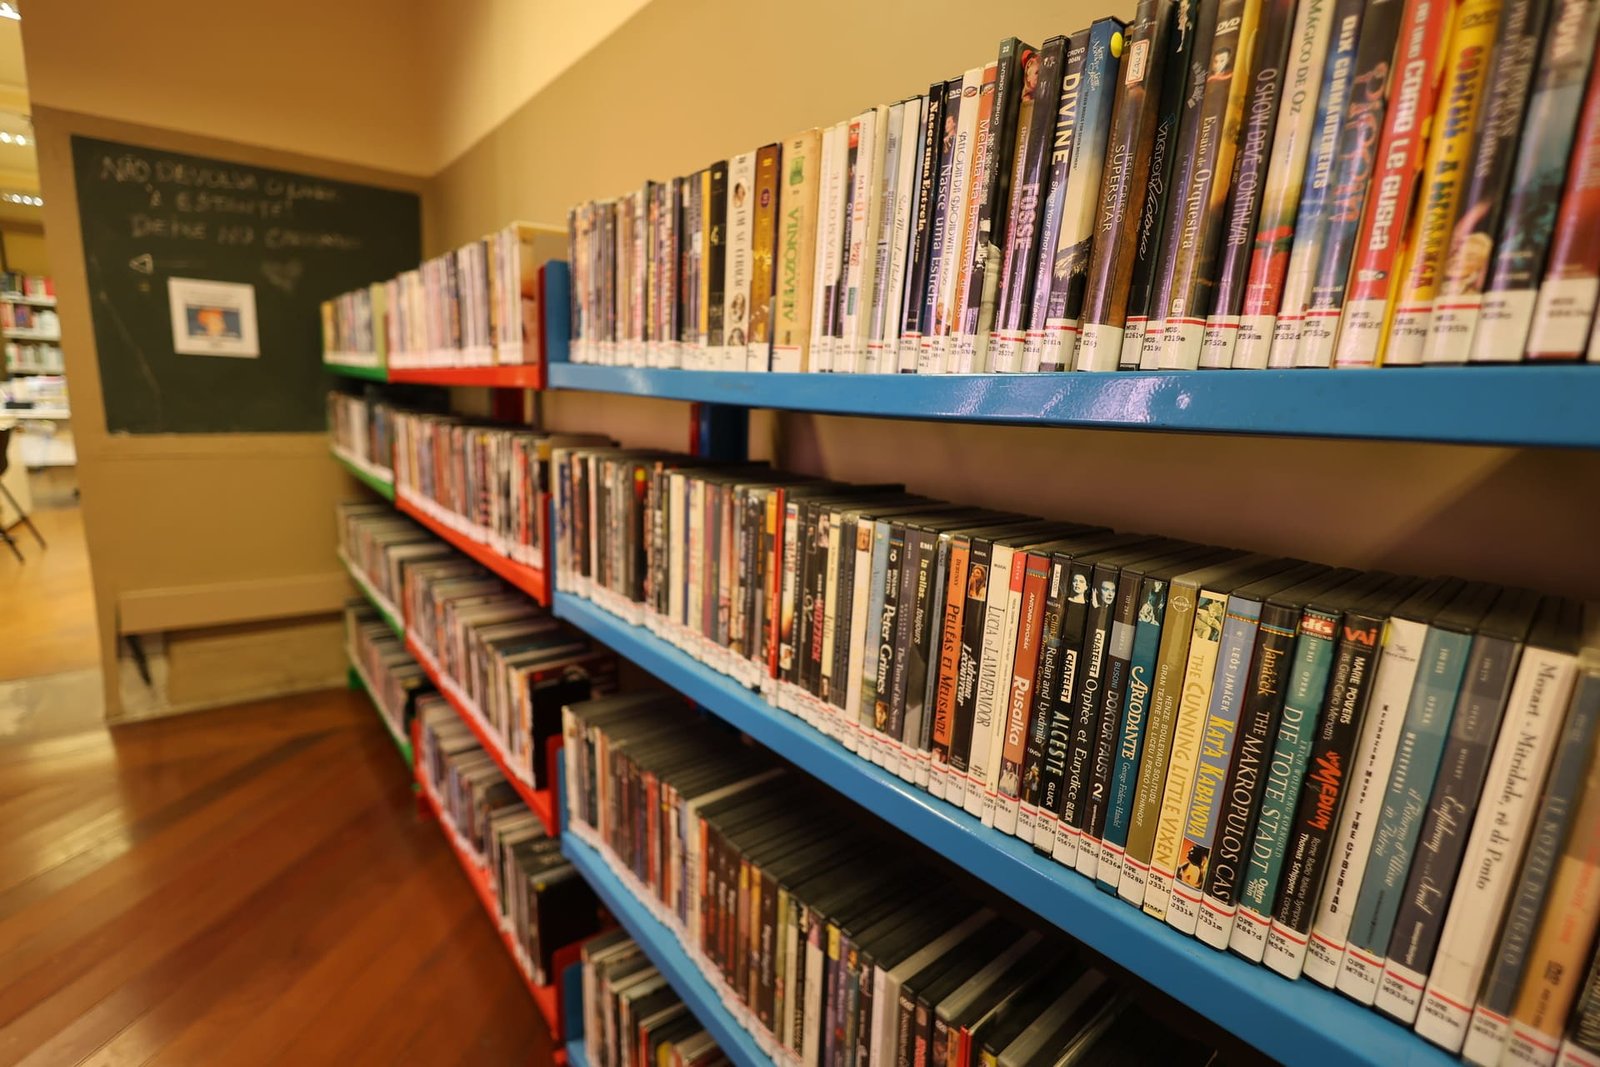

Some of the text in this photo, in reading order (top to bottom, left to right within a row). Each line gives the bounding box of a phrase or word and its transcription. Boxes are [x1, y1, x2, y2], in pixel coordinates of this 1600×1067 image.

[1216, 17, 1241, 32] DVD
[1052, 72, 1081, 166] DIVINE
[1251, 82, 1276, 124] SHOW
[1201, 116, 1217, 156] Ensaio
[1246, 124, 1267, 168] DEVE
[1101, 144, 1126, 233] SUPERSTAR
[1182, 168, 1211, 249] Orquestra
[876, 604, 895, 695] Peter Grimes
[946, 604, 961, 658] PELLÉAS
[942, 660, 951, 672] ET
[957, 643, 972, 706] Lecouvreur
[964, 658, 977, 699] Adriana
[976, 606, 1005, 727] LUCIA LAMMERMOOR
[1061, 649, 1076, 701] CHATELET
[1111, 661, 1121, 691] BUSONI
[1258, 647, 1284, 696] Janáček
[1340, 657, 1366, 725] MARIE POWERS
[1527, 661, 1558, 717] Mozart
[1007, 675, 1031, 747] Rusalka
[1034, 647, 1058, 751] Ruslan and Lyudmila
[1064, 629, 1105, 823] CHATELET et Eurydice GLUCK
[1104, 691, 1119, 740] DOKTOR
[1122, 665, 1149, 761] ARIODANTE
[1254, 712, 1269, 737] THE
[1045, 711, 1070, 807] ALCESTE GLUCK
[1097, 744, 1111, 781] FAUST
[1148, 695, 1172, 804] HENZE: BOULEVARD SOLITUDE
[1156, 655, 1204, 867] THE CUNNING LITTLE VIXEN
[1498, 732, 1537, 805] Mitridade,
[1220, 735, 1262, 856] MAKROPULOS
[1251, 706, 1303, 881] DIE TOTE STADT
[1287, 832, 1309, 895] Thomas Schippers
[1330, 812, 1362, 914] THE CYBERIAD
[1476, 849, 1502, 891] Ponto
[1170, 904, 1194, 918] J331k
